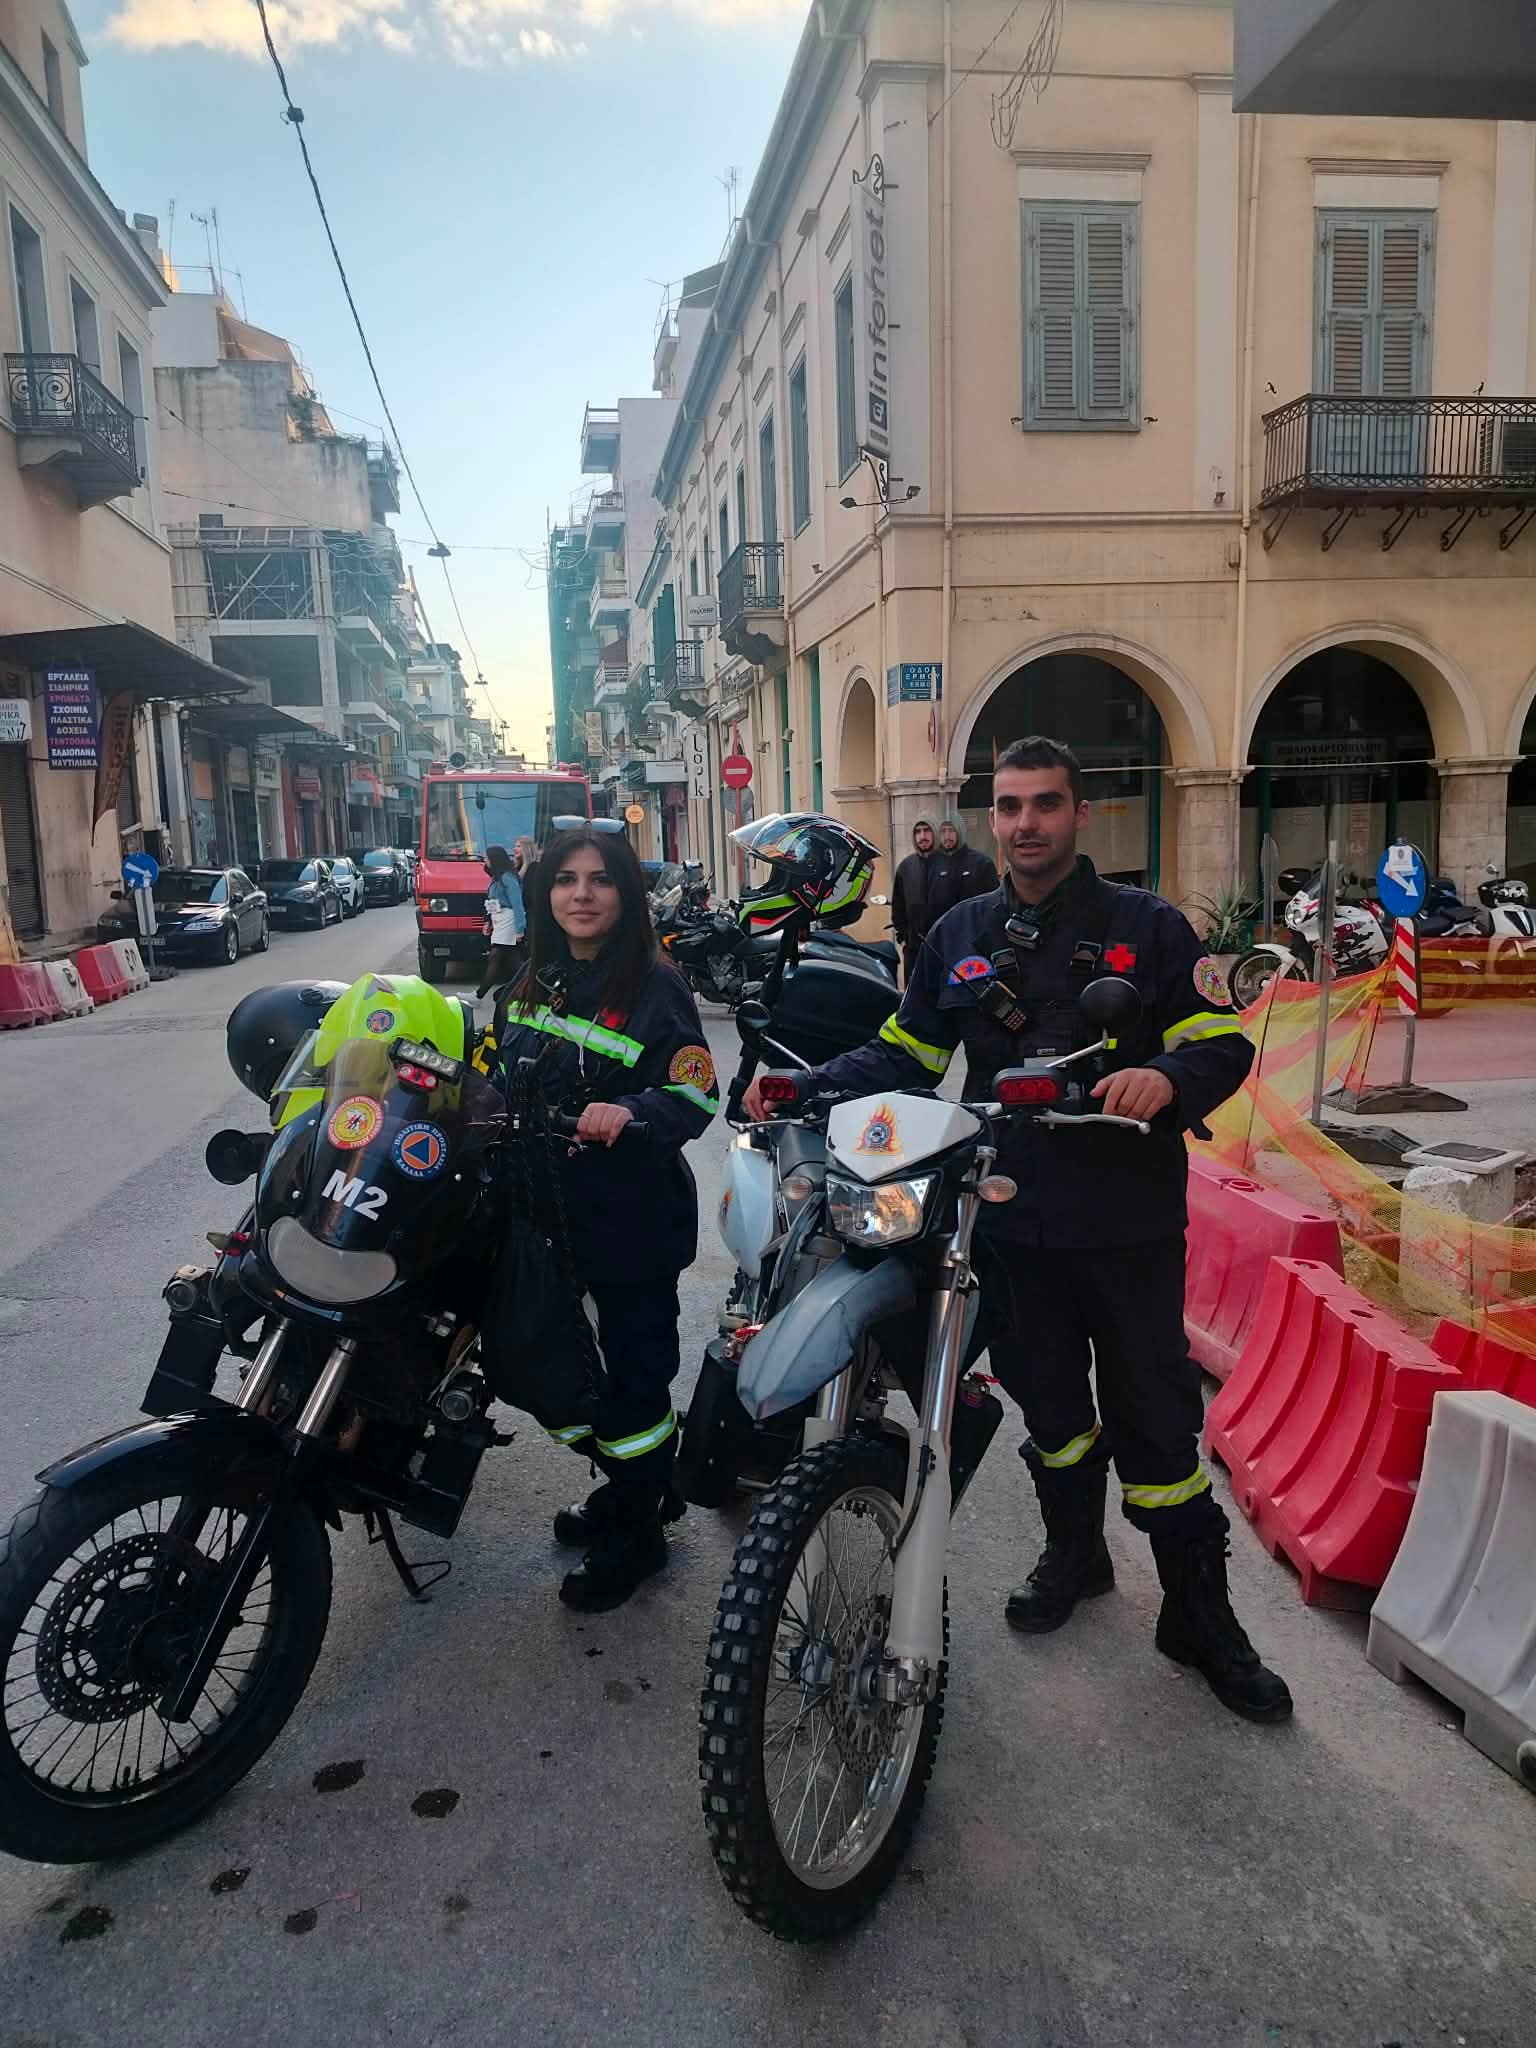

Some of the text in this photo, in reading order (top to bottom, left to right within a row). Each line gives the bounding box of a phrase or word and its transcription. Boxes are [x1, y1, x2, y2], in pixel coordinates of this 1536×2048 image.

[909, 666, 937, 674] ΟΔΟ
[47, 672, 90, 681] ΕΡΓΑΛΕΙΑ
[47, 683, 89, 692] ΣΙΔΗΡΙΚΑ
[49, 694, 91, 703] ΧΡΩΜΑΤΑ
[52, 705, 89, 714] ΣΧΟΙΝΙΑ
[50, 716, 93, 725] ΠΛΑΣΤΙΚΑ
[56, 726, 88, 735] ΔΟΧΕΙΑ
[51, 748, 97, 757] ΕΛΑΙΟΠΑΝΑ
[321, 1168, 389, 1222] M2
